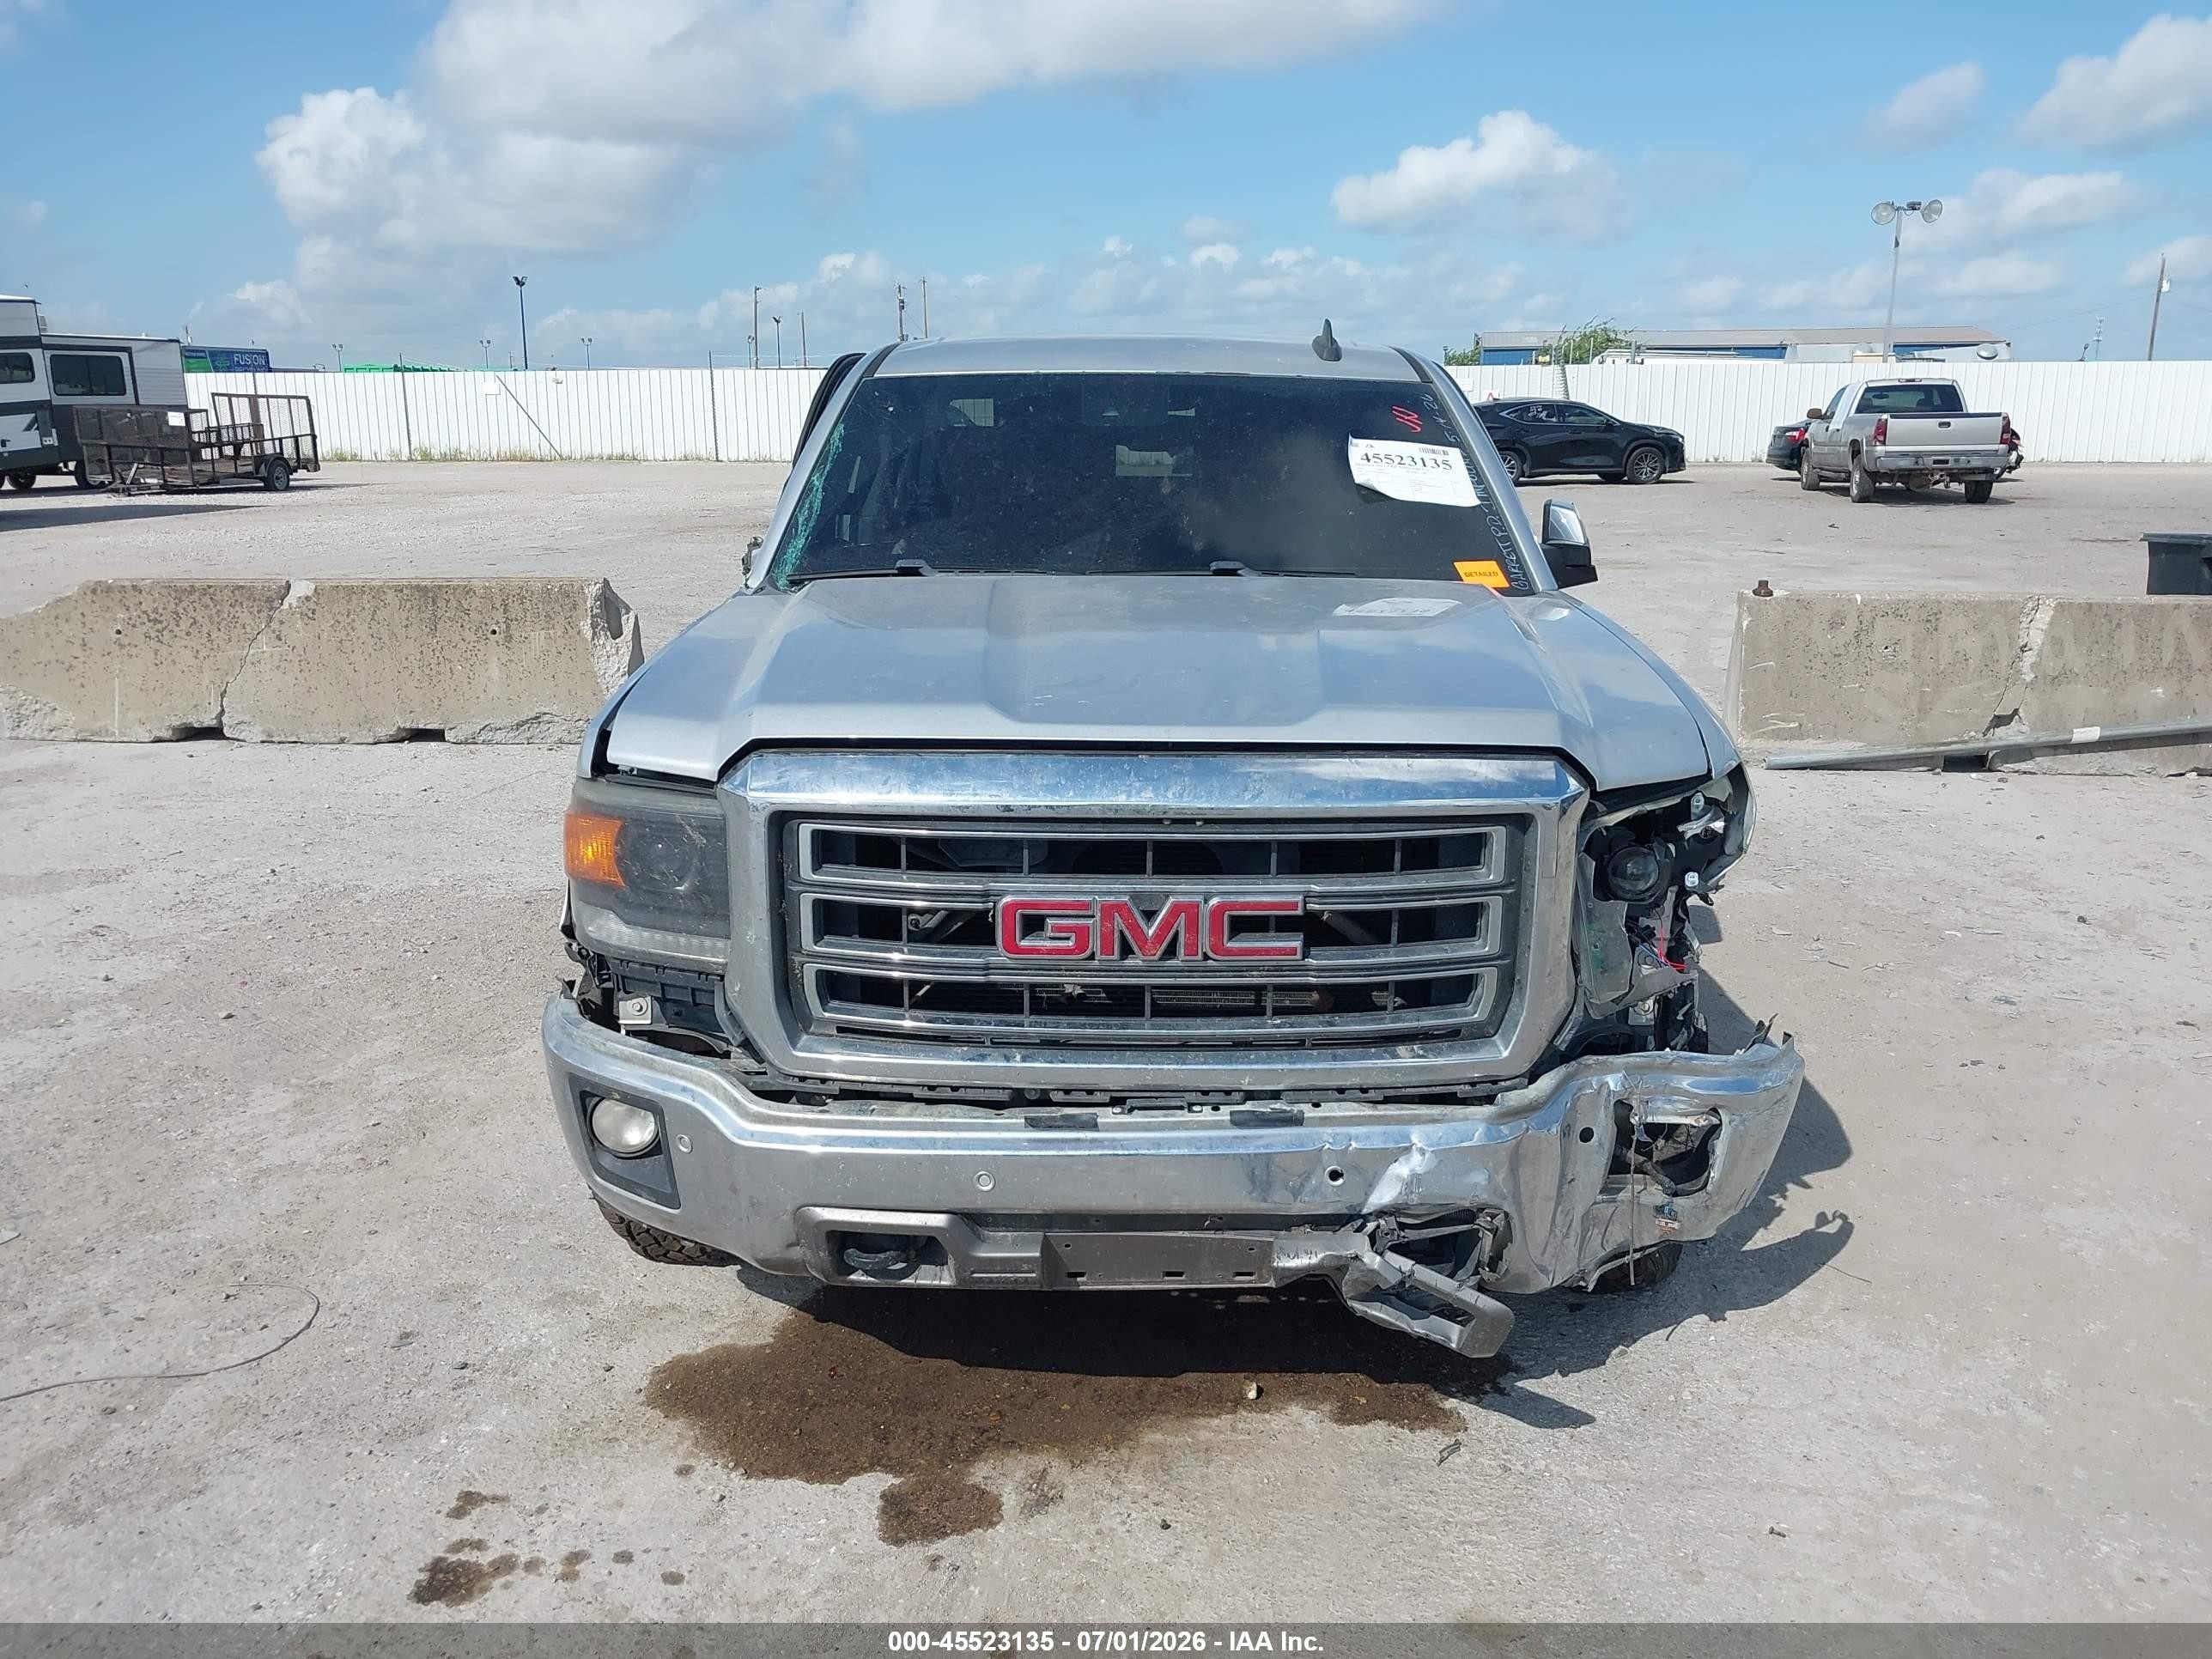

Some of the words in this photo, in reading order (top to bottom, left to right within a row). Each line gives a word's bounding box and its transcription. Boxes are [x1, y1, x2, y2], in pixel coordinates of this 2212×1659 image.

[1359, 451, 1453, 471] 45523135
[1464, 570, 1499, 579] DETAILED
[995, 894, 1306, 962] GMC
